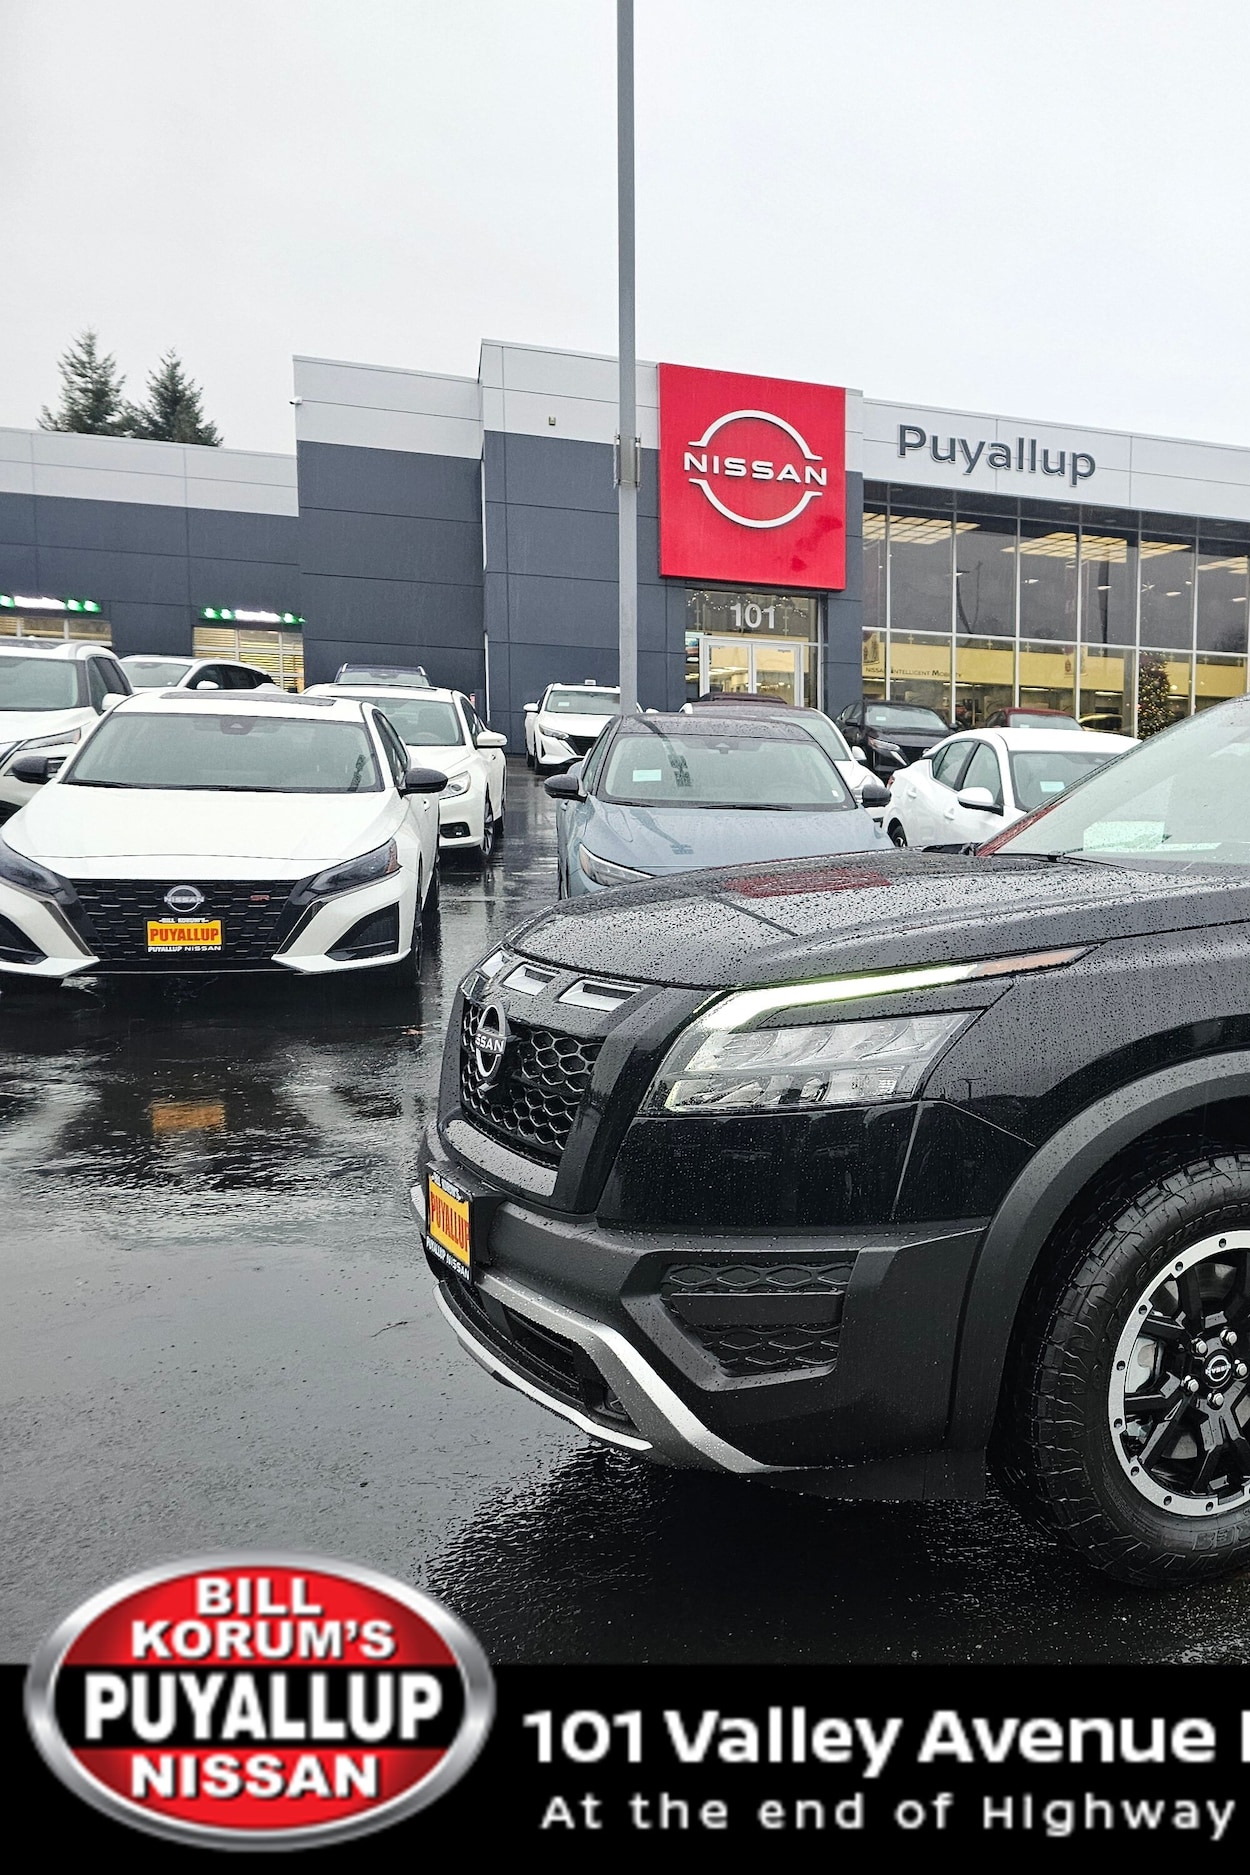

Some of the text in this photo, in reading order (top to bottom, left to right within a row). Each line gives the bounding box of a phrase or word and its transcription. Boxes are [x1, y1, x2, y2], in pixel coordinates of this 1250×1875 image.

[683, 450, 828, 486] NISSAN
[897, 423, 1097, 487] Puyallup
[730, 602, 776, 629] 101
[150, 928, 219, 941] PUYALLUP
[430, 1190, 470, 1253] PUYALLUP
[446, 1253, 471, 1281] NISSAN
